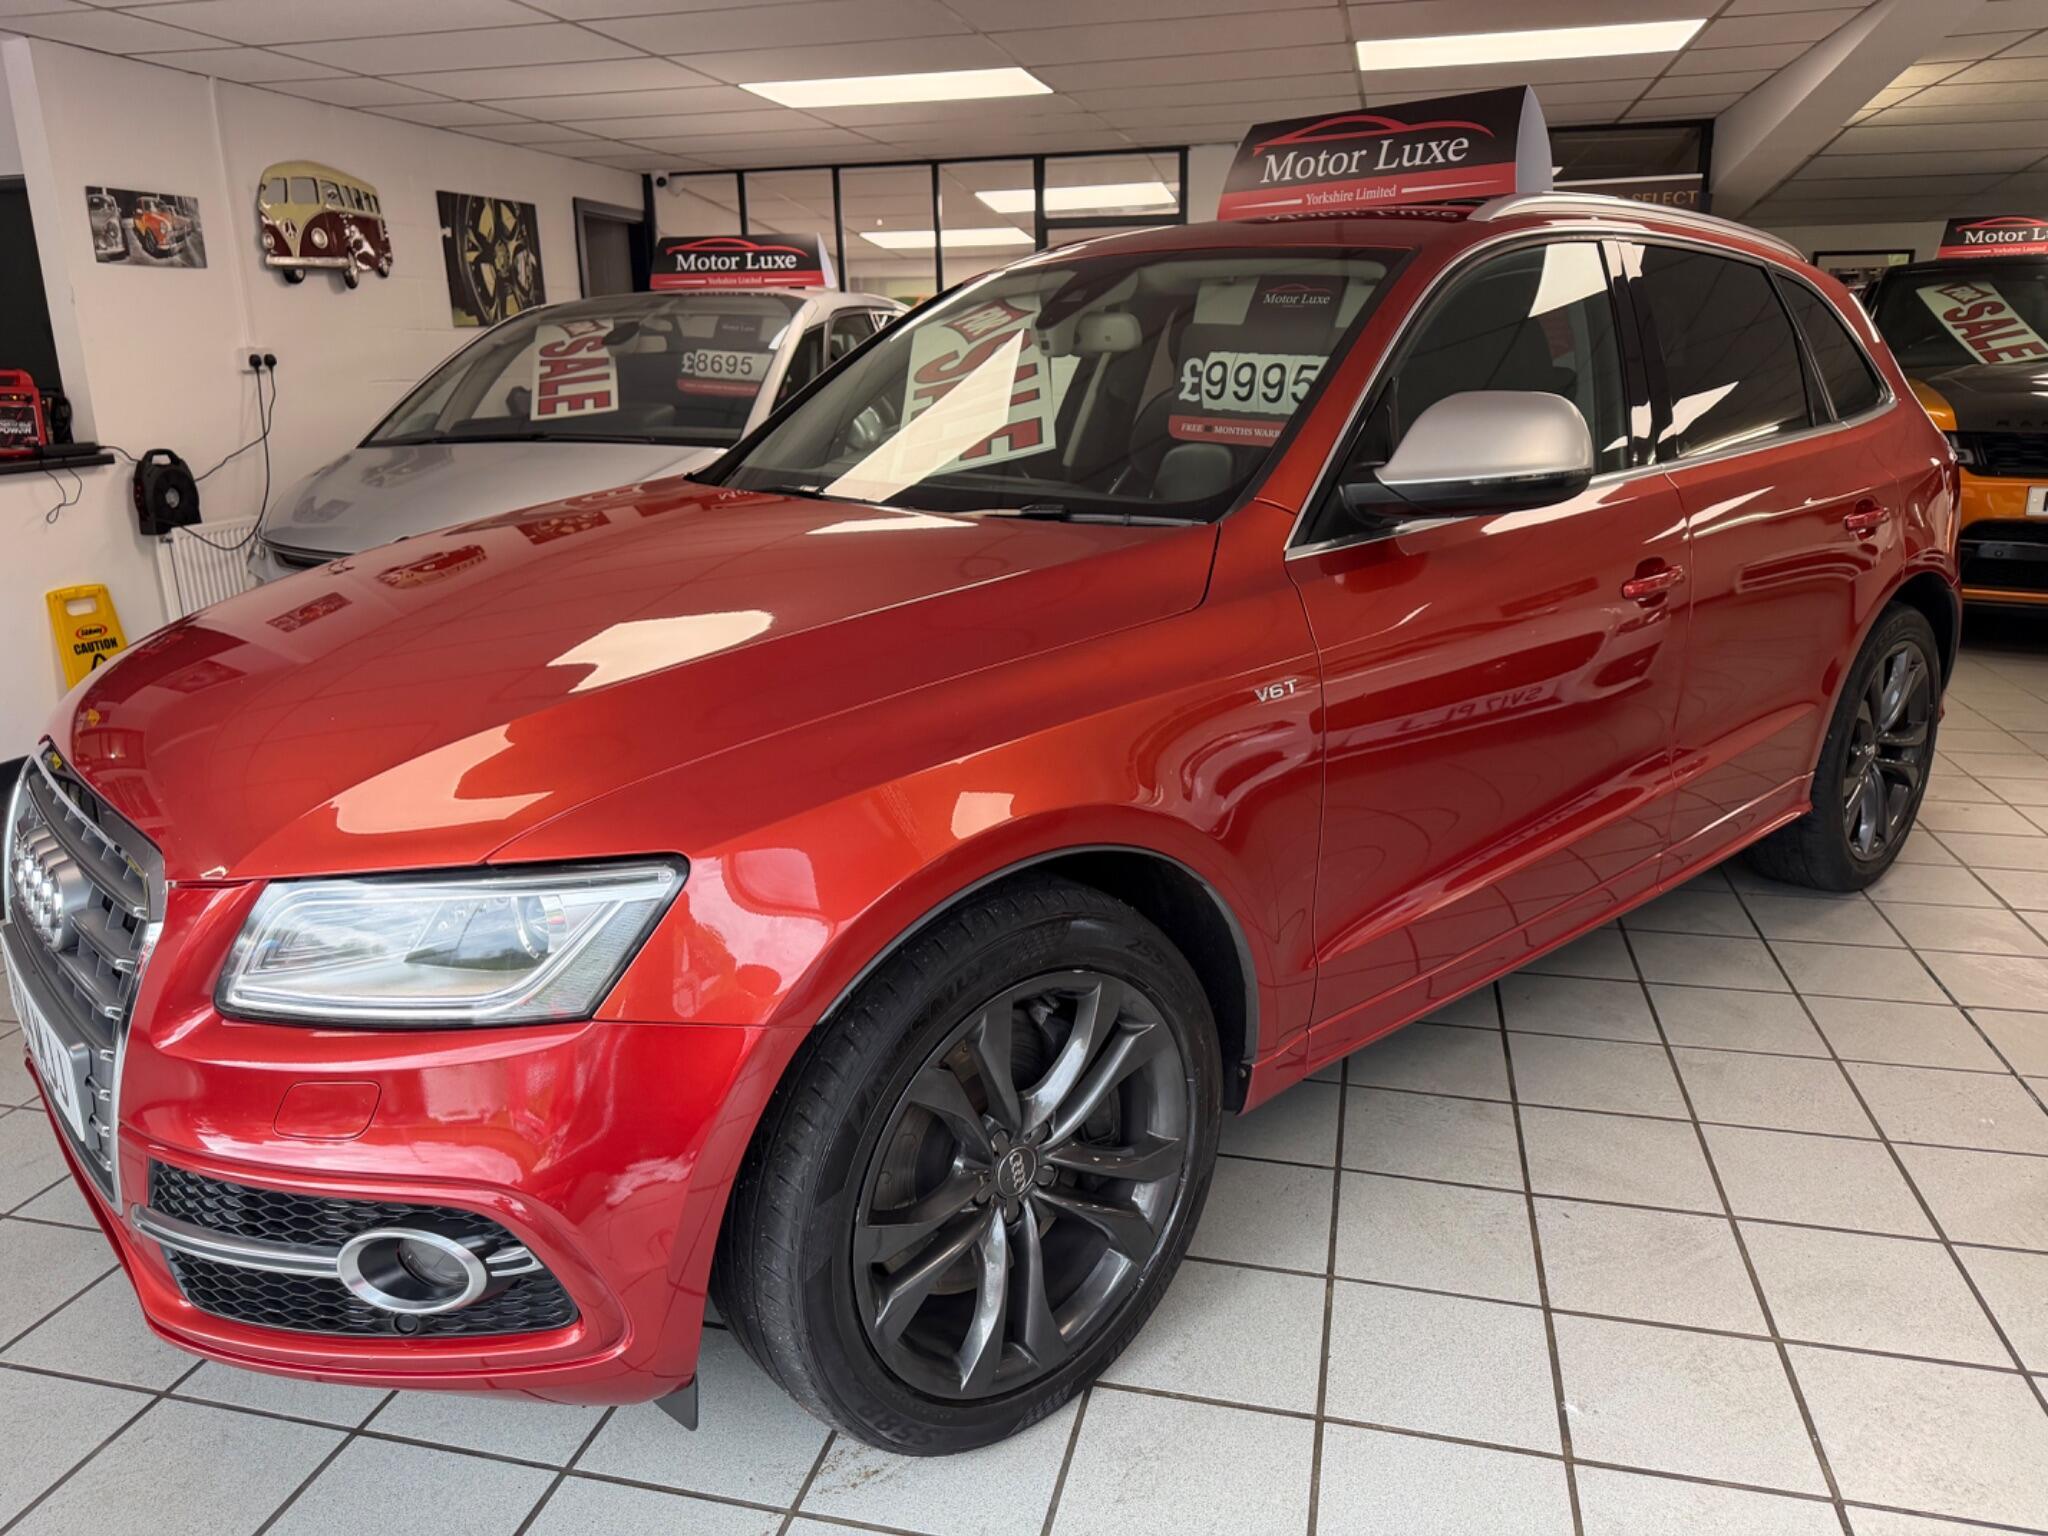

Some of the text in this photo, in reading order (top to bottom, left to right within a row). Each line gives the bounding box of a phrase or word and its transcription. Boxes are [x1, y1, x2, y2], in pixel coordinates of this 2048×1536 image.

[1260, 136, 1469, 183] Motor Luxe
[1305, 184, 1396, 206] Yorkshire Limited
[1631, 190, 1698, 205] SELECT
[1963, 230, 2028, 244] Motor
[675, 252, 797, 271] Motor Luxe
[1263, 293, 1330, 304] Motor Luxe
[1943, 300, 2045, 364] SALE
[681, 351, 753, 376] £8695
[537, 335, 611, 416] SALE
[1178, 357, 1318, 404] £9995
[1181, 423, 1203, 433] FREE
[1213, 426, 1252, 437] MONTHS
[73, 637, 118, 656] CAUTION
[1254, 678, 1297, 702] V6T
